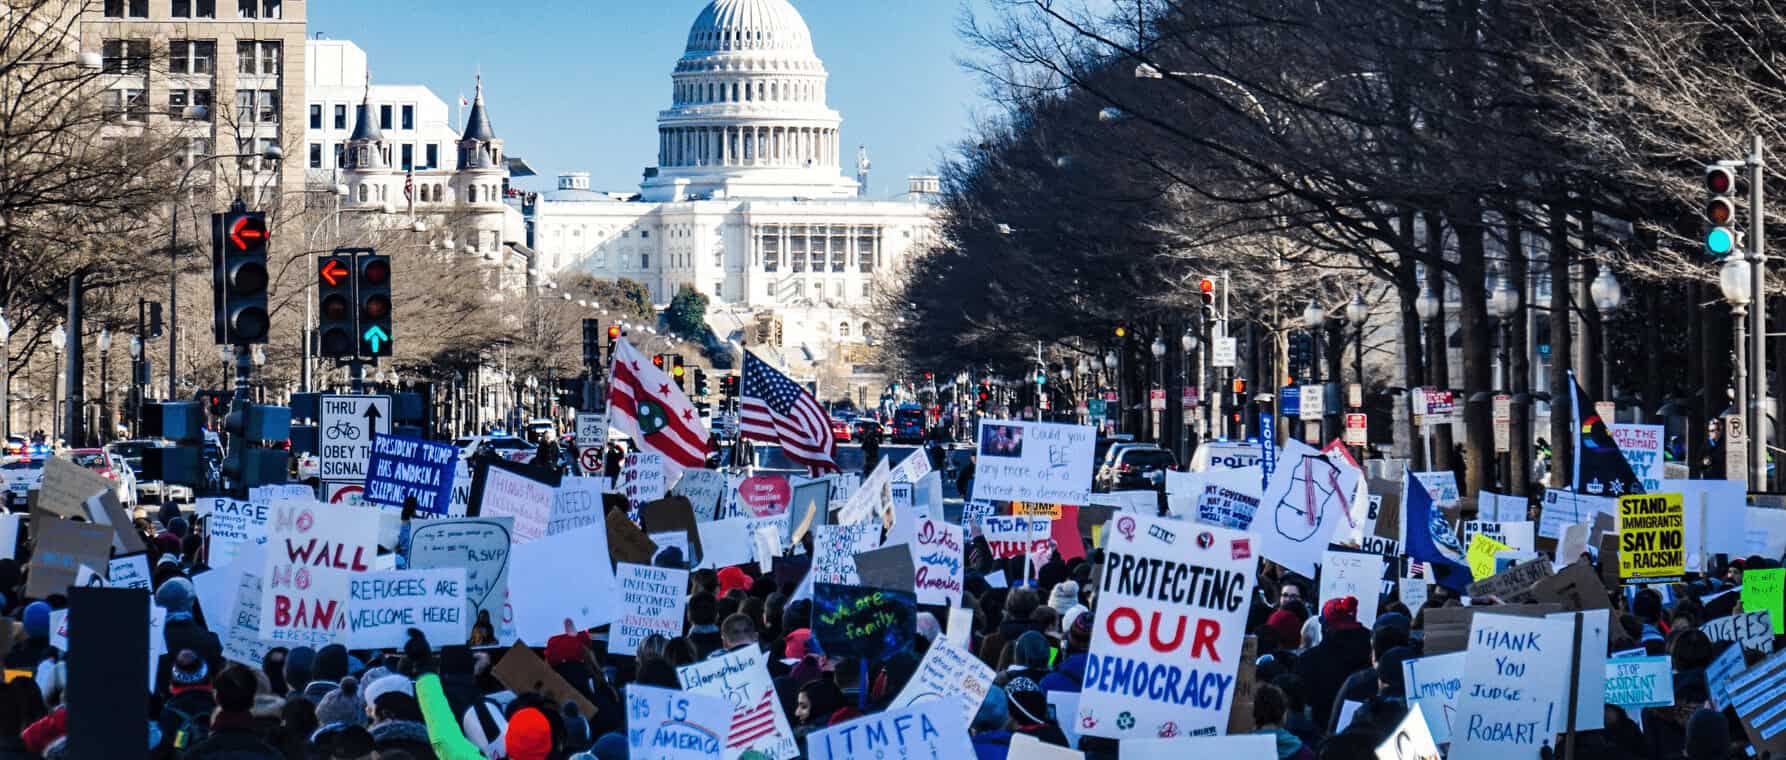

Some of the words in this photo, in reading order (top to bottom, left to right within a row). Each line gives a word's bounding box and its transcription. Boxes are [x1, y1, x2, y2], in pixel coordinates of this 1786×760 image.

[326, 401, 356, 415] THRU
[1032, 427, 1060, 441] Could
[1068, 431, 1086, 445] you
[1635, 430, 1656, 439] THE
[324, 446, 355, 458] OBEY
[375, 437, 418, 458] PRESIDENT
[423, 444, 453, 465] TRUMP
[625, 454, 638, 466] NO
[640, 454, 661, 464] HATE
[1048, 445, 1071, 464] BE
[324, 462, 365, 475] SIGNAL
[1212, 457, 1263, 468] POLI
[377, 459, 392, 477] HAS
[395, 462, 431, 484] AWOKEN
[433, 468, 441, 486] A
[626, 470, 638, 481] NO
[980, 464, 998, 479] any
[1004, 464, 1029, 476] more
[1038, 468, 1050, 481] of
[369, 480, 406, 502] SLEEPING
[626, 486, 638, 497] NO
[214, 499, 269, 520] RAGE
[555, 490, 592, 516] NEED
[1622, 498, 1666, 514] STAND
[276, 507, 314, 533] NO
[1466, 522, 1478, 531] NO
[1622, 514, 1682, 528] IMMIGRANTS!
[1624, 531, 1656, 552] SAY
[1660, 530, 1682, 550] NO
[286, 538, 368, 571] WALL
[468, 549, 504, 562] RSVP
[1624, 561, 1631, 569] to
[1634, 551, 1682, 568] RACISM!
[920, 553, 959, 575] sing
[272, 565, 310, 590] NO
[634, 567, 668, 581] WHEN
[350, 578, 426, 600] REFUGEES
[434, 580, 458, 598] ARE
[624, 578, 680, 596] INJUSTICE
[625, 592, 676, 608] BECOMES
[856, 592, 883, 610] are
[274, 595, 338, 630] BAN
[350, 607, 416, 632] WELCOME
[423, 607, 460, 625] HERE!
[638, 606, 662, 617] LAW
[272, 630, 336, 644] #RESIST
[1106, 607, 1222, 662] OUR
[1476, 630, 1542, 652] THANK
[680, 656, 755, 690] Islamophobia
[1495, 658, 1526, 678] YOU
[1617, 663, 1640, 676] STOP
[1084, 654, 1232, 710] DEMOCRACY
[1604, 674, 1656, 692] RESIDENT
[1470, 684, 1521, 701] JUDGE
[1604, 688, 1653, 704] BANNON
[652, 728, 720, 754] AMERICA
[826, 713, 939, 760] ITMFA
